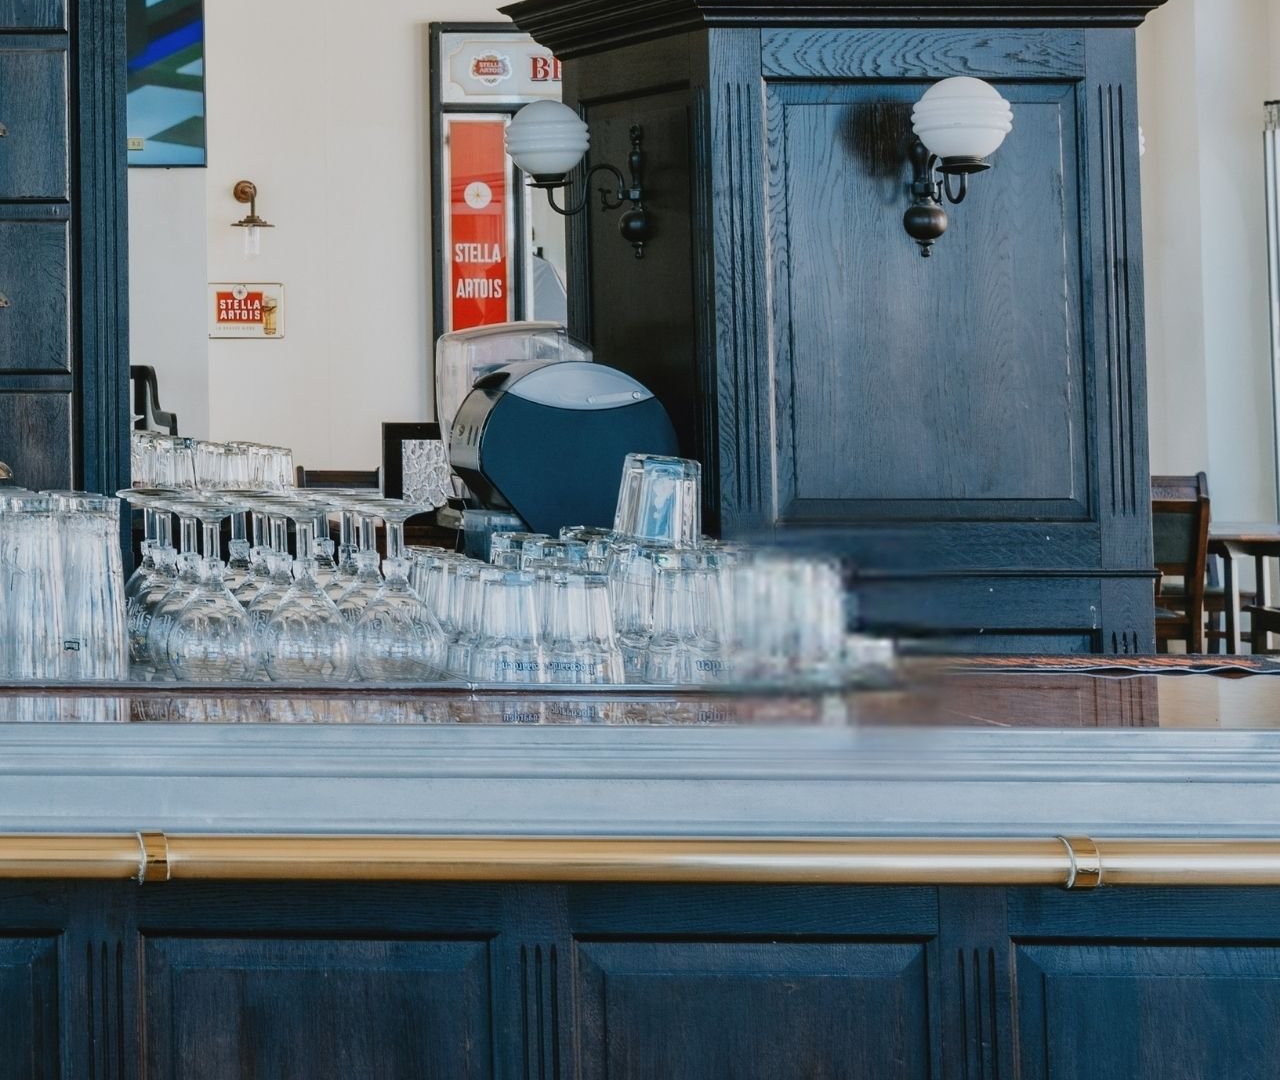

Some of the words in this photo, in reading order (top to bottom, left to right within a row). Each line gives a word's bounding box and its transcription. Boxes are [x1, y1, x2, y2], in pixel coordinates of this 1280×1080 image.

[455, 243, 502, 263] STELLA
[455, 278, 503, 299] ARTOIS
[220, 299, 260, 309] STELLA
[220, 310, 260, 320] ARTOIS
